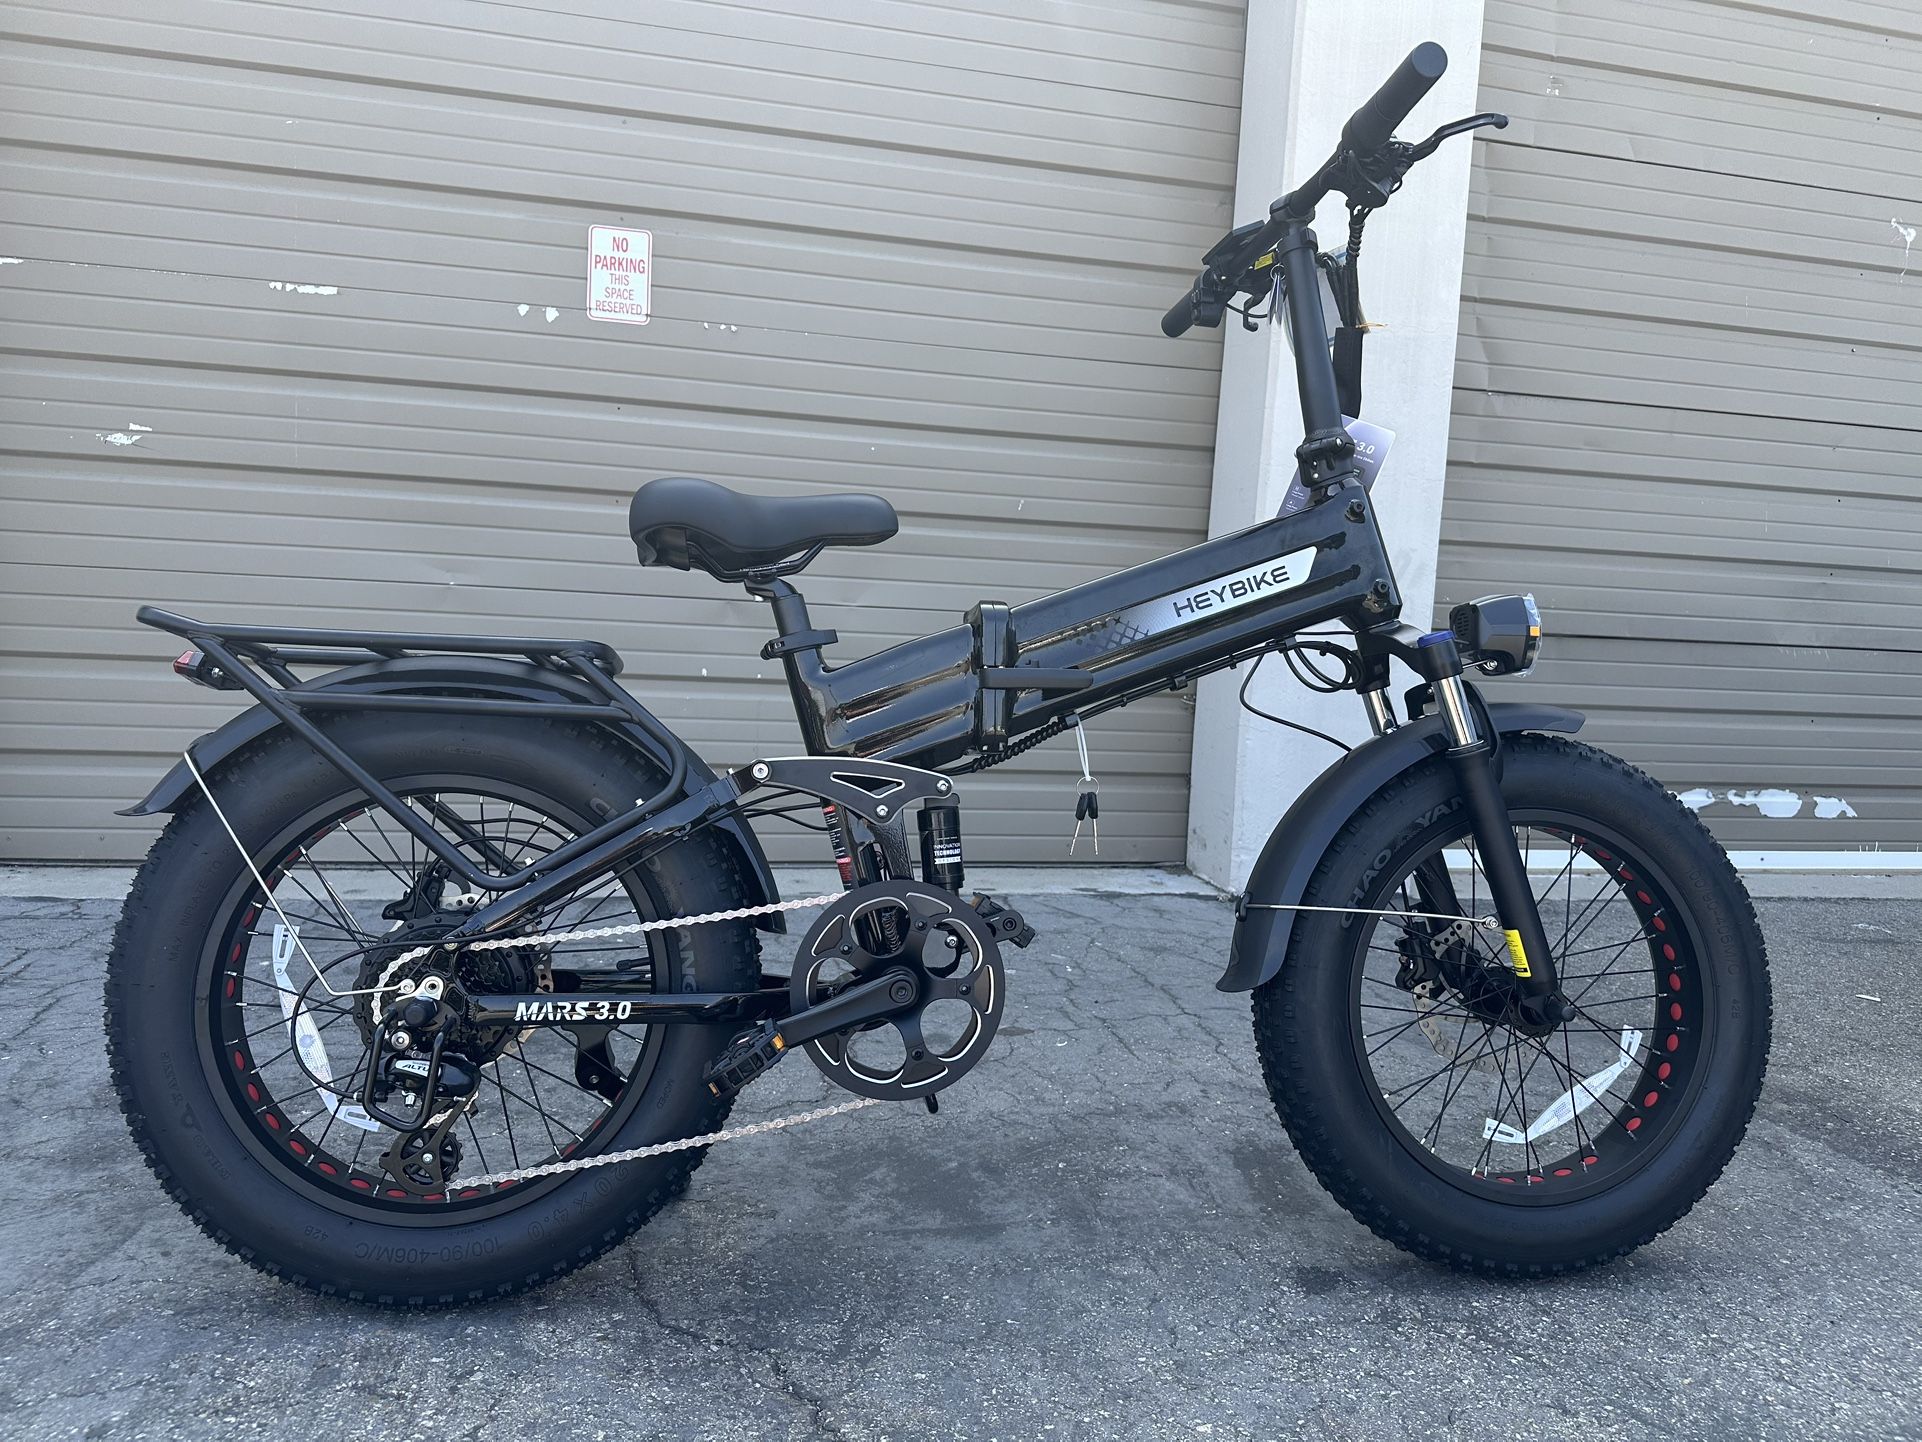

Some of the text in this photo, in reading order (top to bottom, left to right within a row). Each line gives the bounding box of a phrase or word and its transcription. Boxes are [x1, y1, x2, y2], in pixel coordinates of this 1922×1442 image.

[612, 236, 629, 253] NO
[594, 254, 646, 274] PARKING
[609, 273, 630, 286] THIS
[604, 286, 635, 301] SPACE
[595, 300, 643, 316] RESERVED
[1356, 441, 1375, 455] 3.0
[1172, 565, 1290, 618] HEYBIKE
[513, 1000, 632, 1021] MARS 3.0
[401, 1063, 430, 1072] ALTU
